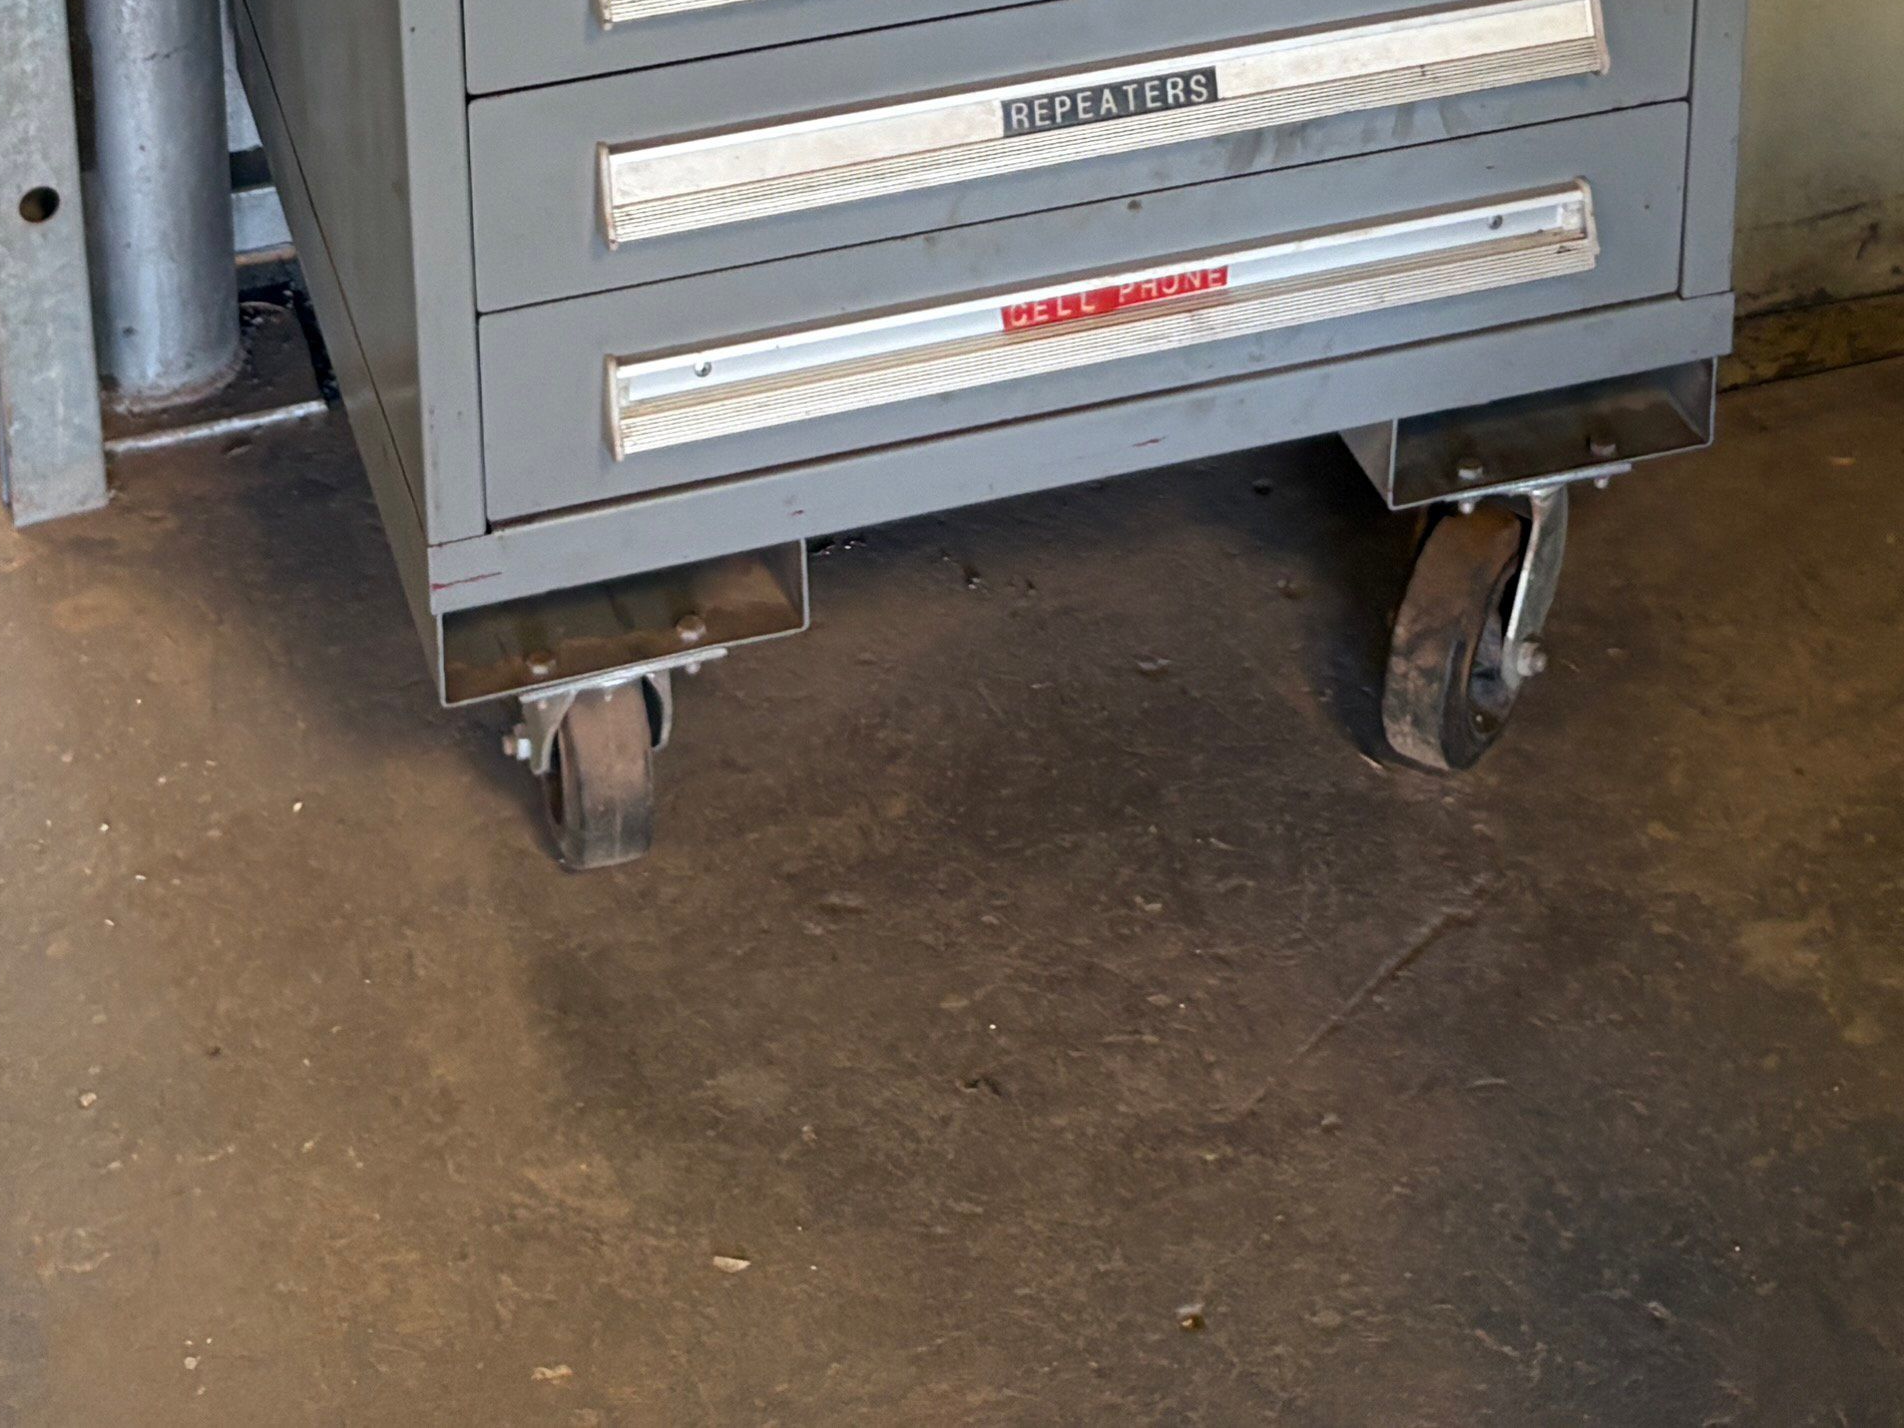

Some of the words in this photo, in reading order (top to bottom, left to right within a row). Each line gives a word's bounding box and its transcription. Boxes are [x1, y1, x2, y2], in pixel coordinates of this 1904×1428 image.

[1010, 73, 1210, 130] REPEATERS
[1008, 292, 1097, 328] CELL
[1118, 266, 1225, 304] PHONE
